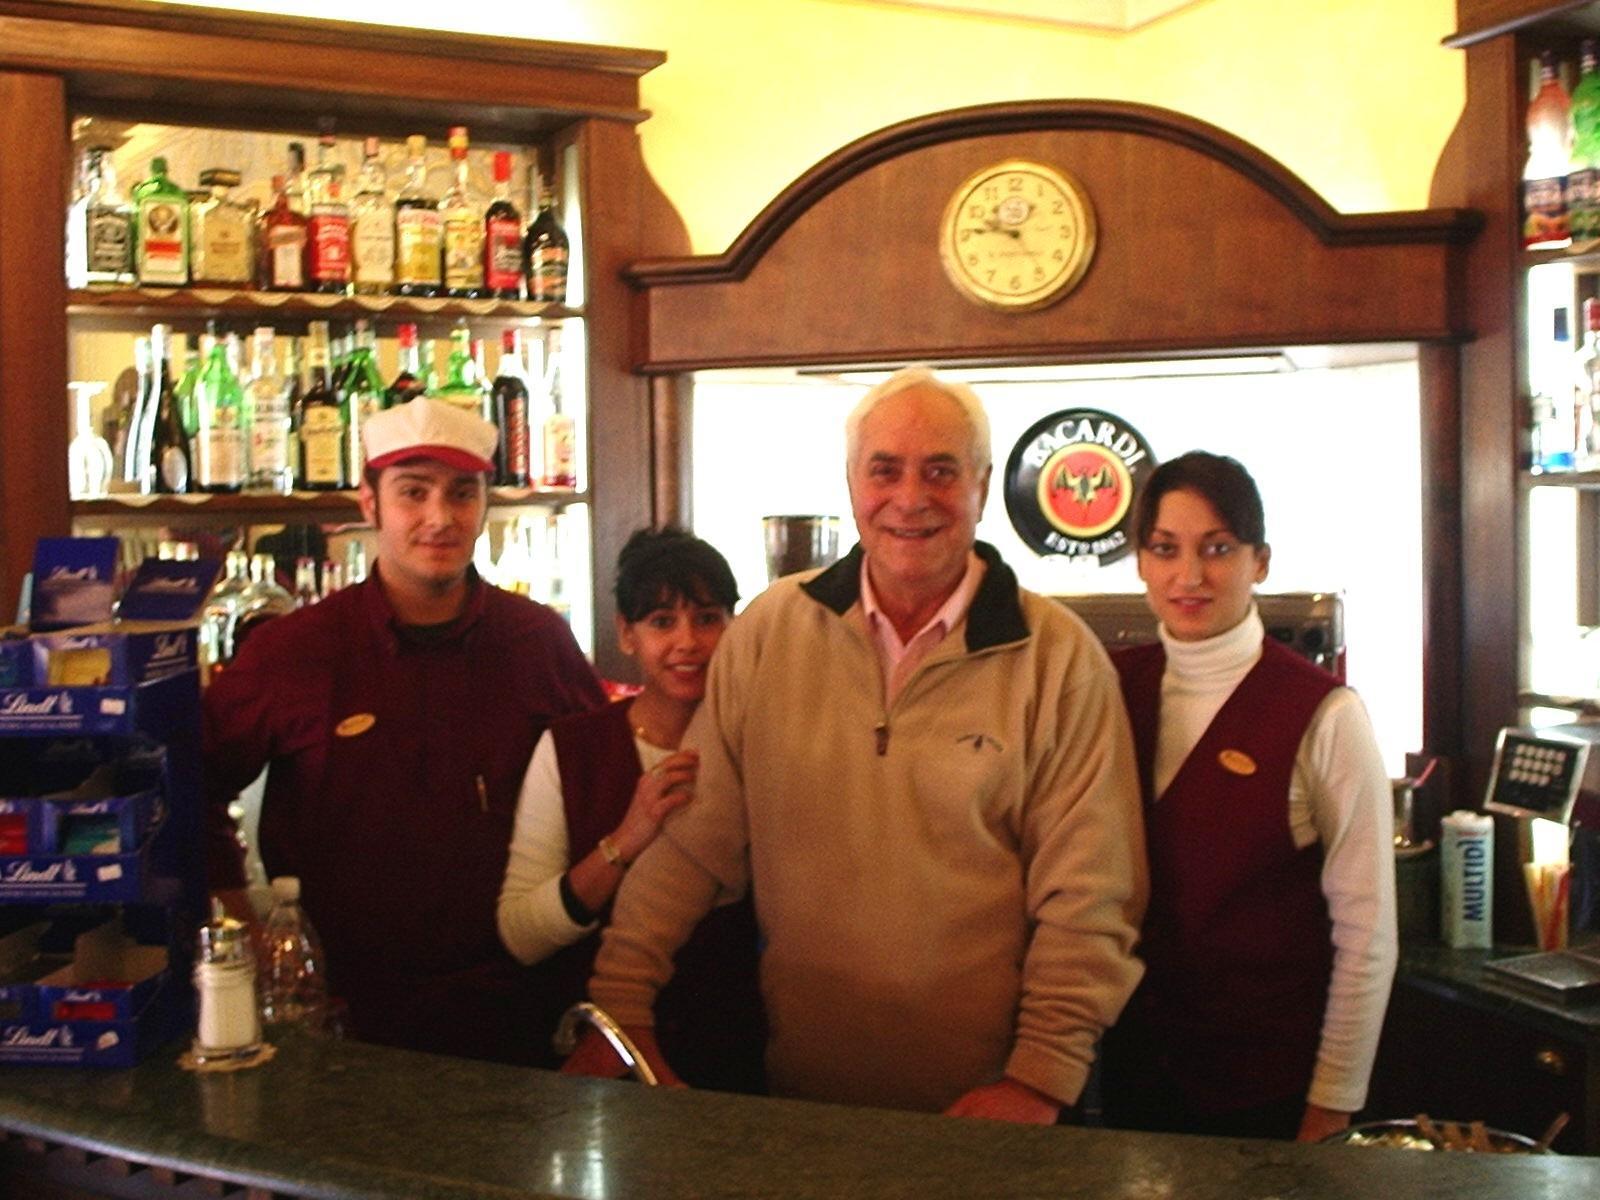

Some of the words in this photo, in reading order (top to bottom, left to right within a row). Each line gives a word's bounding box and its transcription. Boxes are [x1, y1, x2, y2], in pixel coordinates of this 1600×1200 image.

[1008, 177, 1024, 192] 12
[1038, 184, 1044, 197] 1
[1051, 200, 1064, 215] 2
[1060, 224, 1072, 239] 3
[1052, 248, 1064, 262] 4
[987, 269, 997, 282] 7
[1010, 275, 1021, 289] 6
[1022, 418, 1146, 467] BACARDI
[0, 693, 58, 714] Lindt
[5, 861, 62, 882] Lindt
[0, 1025, 59, 1046] Lindt
